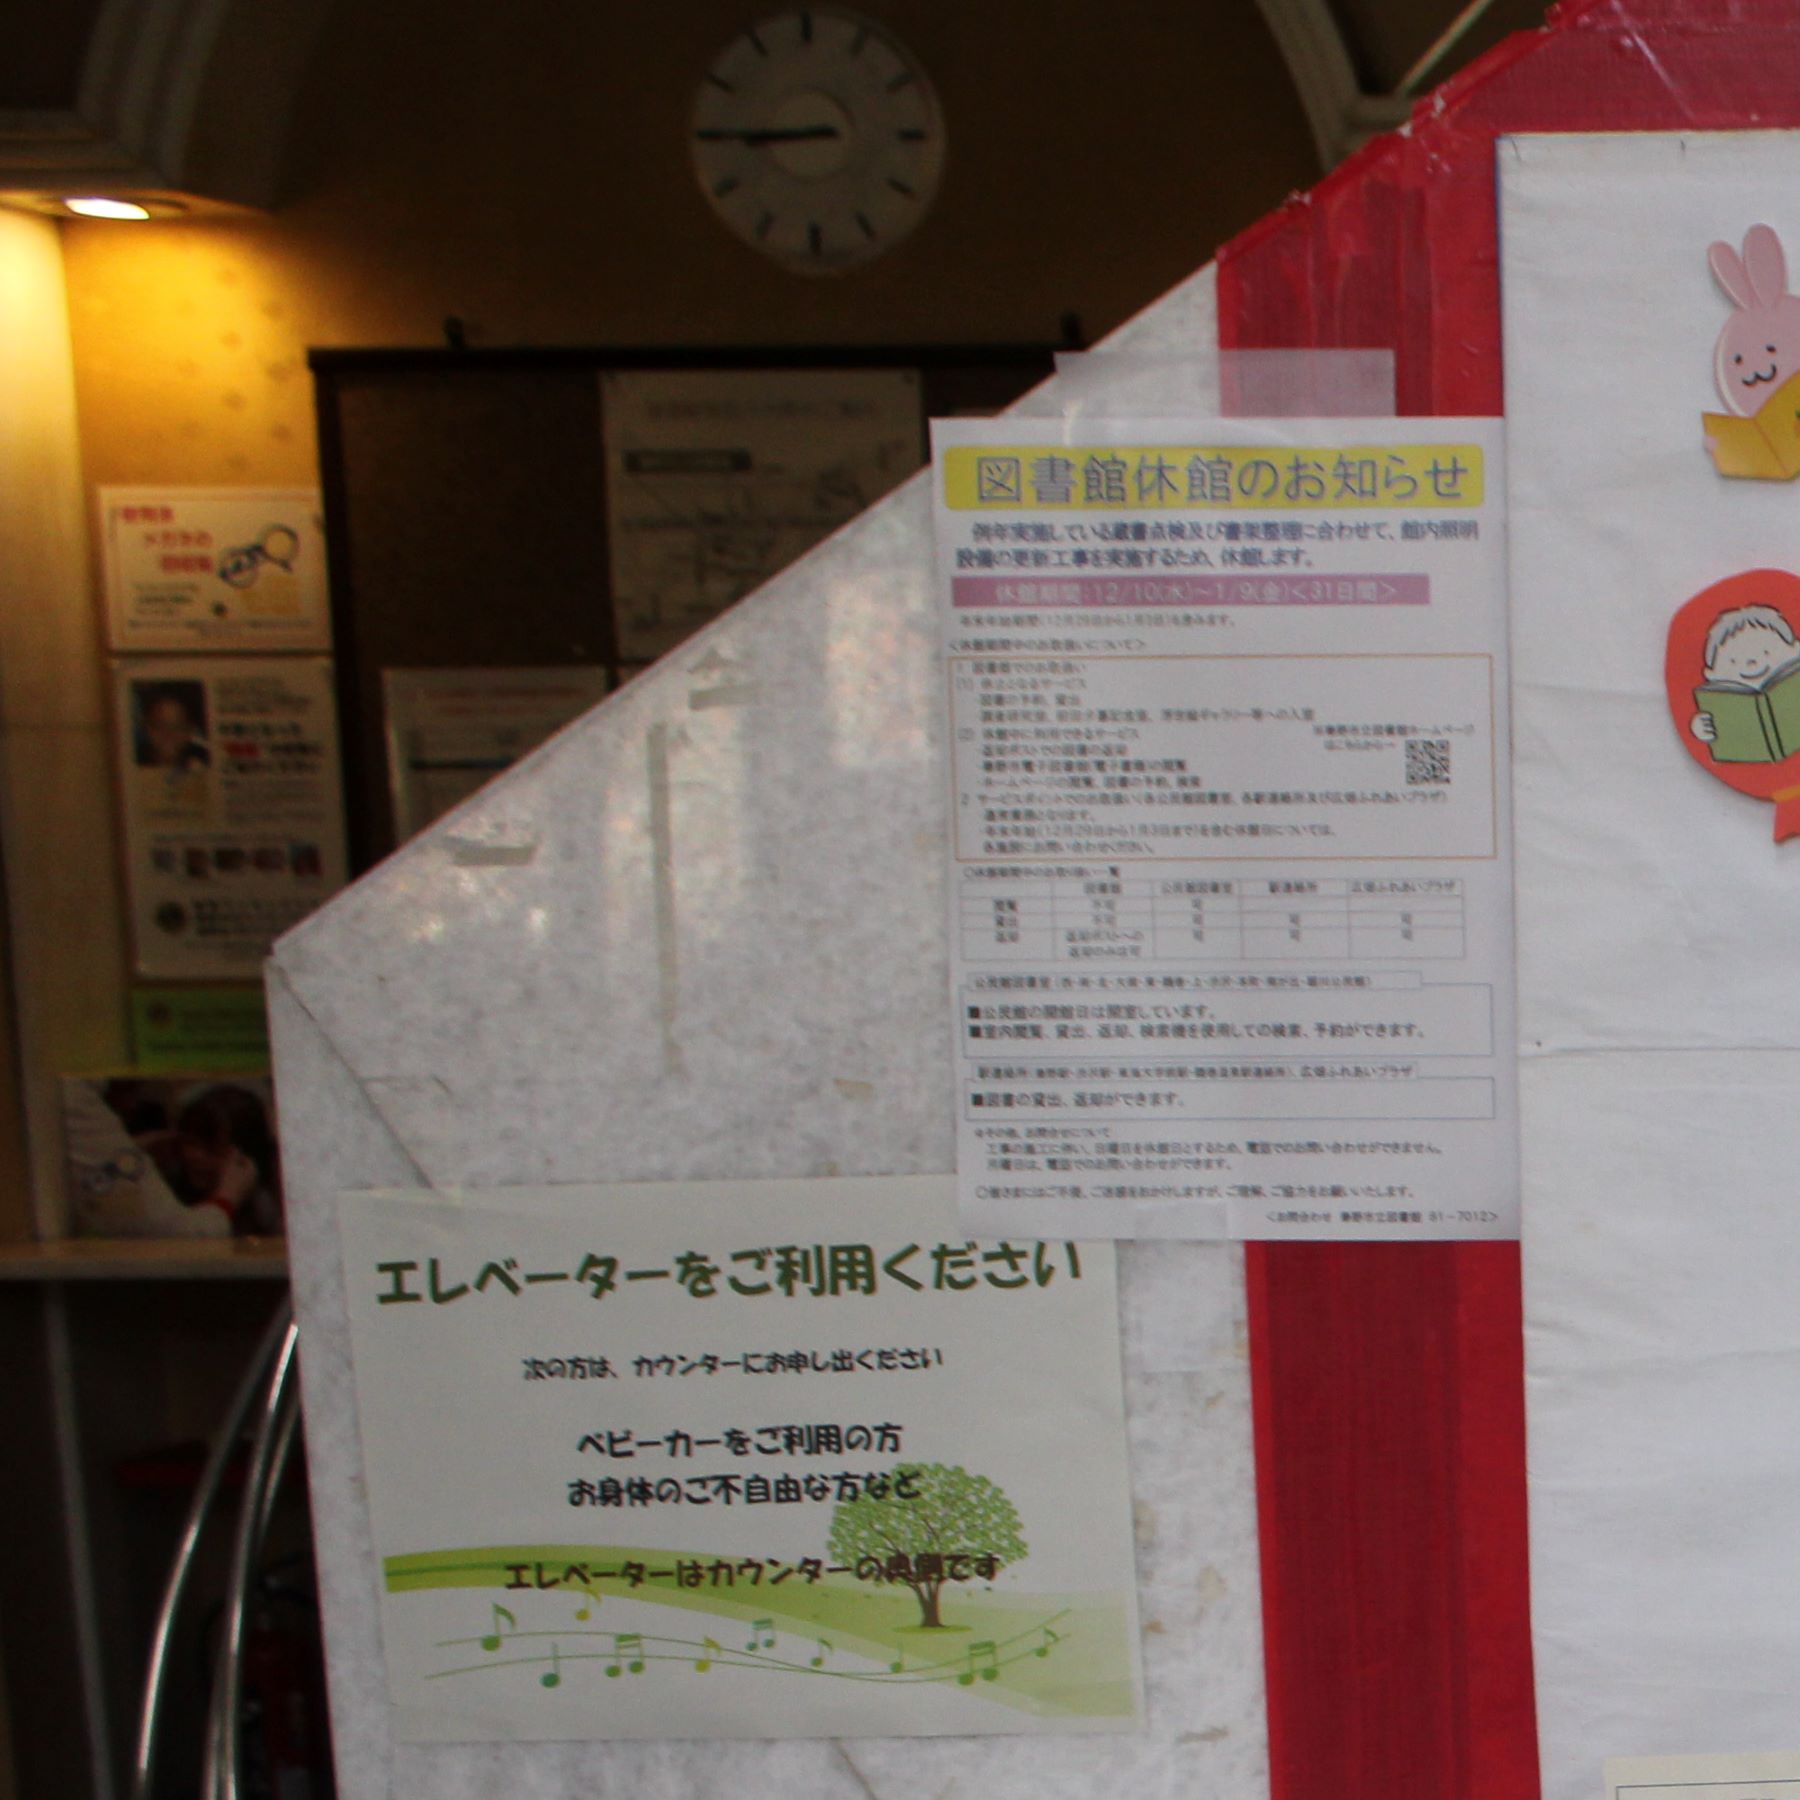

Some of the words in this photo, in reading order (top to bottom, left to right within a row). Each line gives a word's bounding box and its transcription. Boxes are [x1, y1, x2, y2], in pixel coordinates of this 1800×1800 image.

[976, 455, 1469, 502] 図書館休館のお知らせ
[374, 1240, 1082, 1306] エレベーターをご利用ください
[522, 1346, 945, 1382] 次の方は、カウンターにお申し出ください
[576, 1420, 905, 1459] ベビーカーをご利用の方
[566, 1469, 924, 1509] お身体のご不自由な方など
